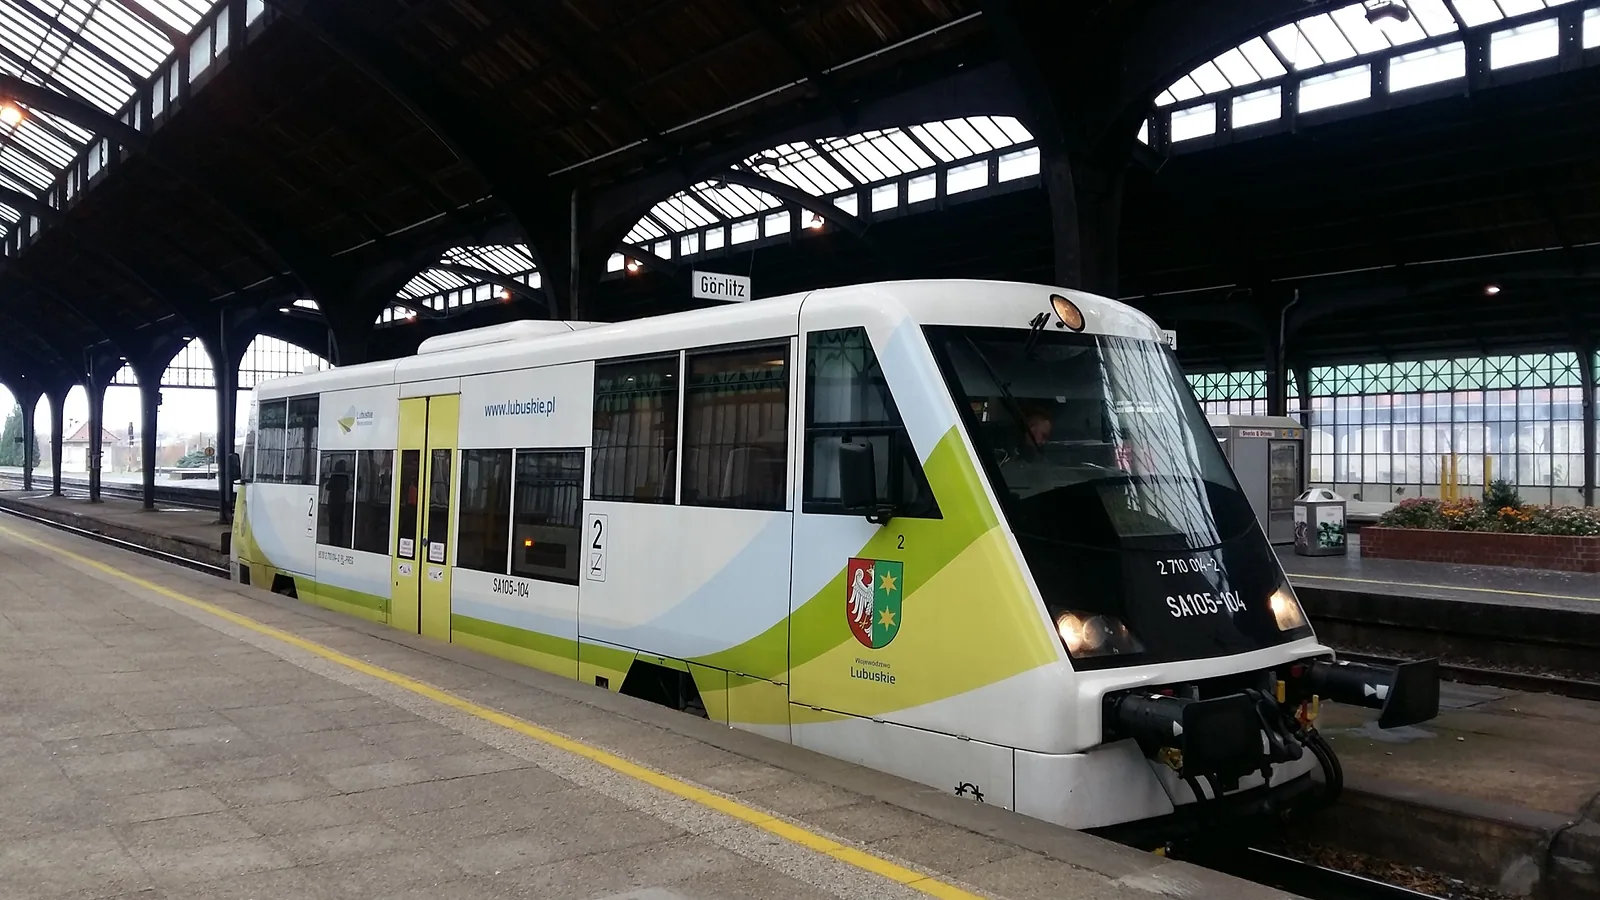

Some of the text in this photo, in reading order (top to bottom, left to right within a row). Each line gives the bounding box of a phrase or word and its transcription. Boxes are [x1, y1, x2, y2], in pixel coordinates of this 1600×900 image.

[701, 276, 745, 297] Görlitz
[484, 396, 556, 417] www.lubuskie.pl
[308, 497, 314, 517] 2
[592, 519, 603, 550] 2
[897, 534, 905, 550] 2
[1156, 560, 1168, 575] 2
[1167, 559, 1188, 574] 710
[493, 578, 529, 598] SA105-104
[1166, 590, 1247, 618] SA105-104
[850, 666, 896, 685] Lubuskie
